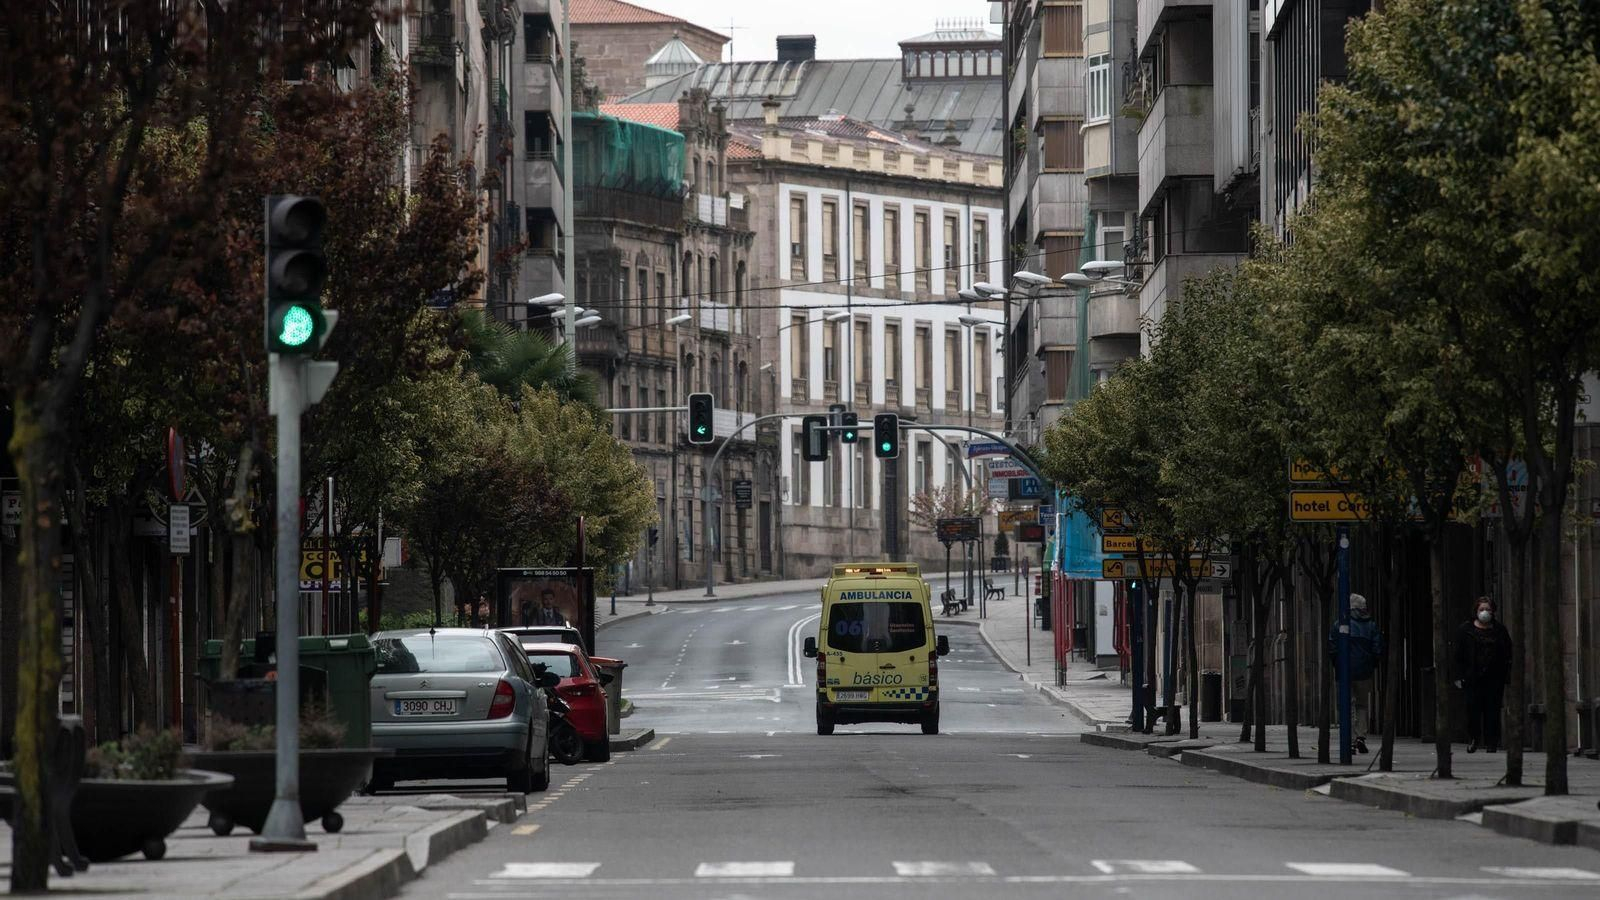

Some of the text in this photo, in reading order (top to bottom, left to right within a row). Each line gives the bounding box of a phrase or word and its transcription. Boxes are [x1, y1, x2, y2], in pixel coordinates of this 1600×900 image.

[1294, 501, 1329, 512] hotel
[1106, 540, 1139, 548] Barcel
[840, 591, 912, 600] AMBULANCIA
[853, 672, 903, 685] básico
[403, 701, 452, 712] 3090 CHJ
